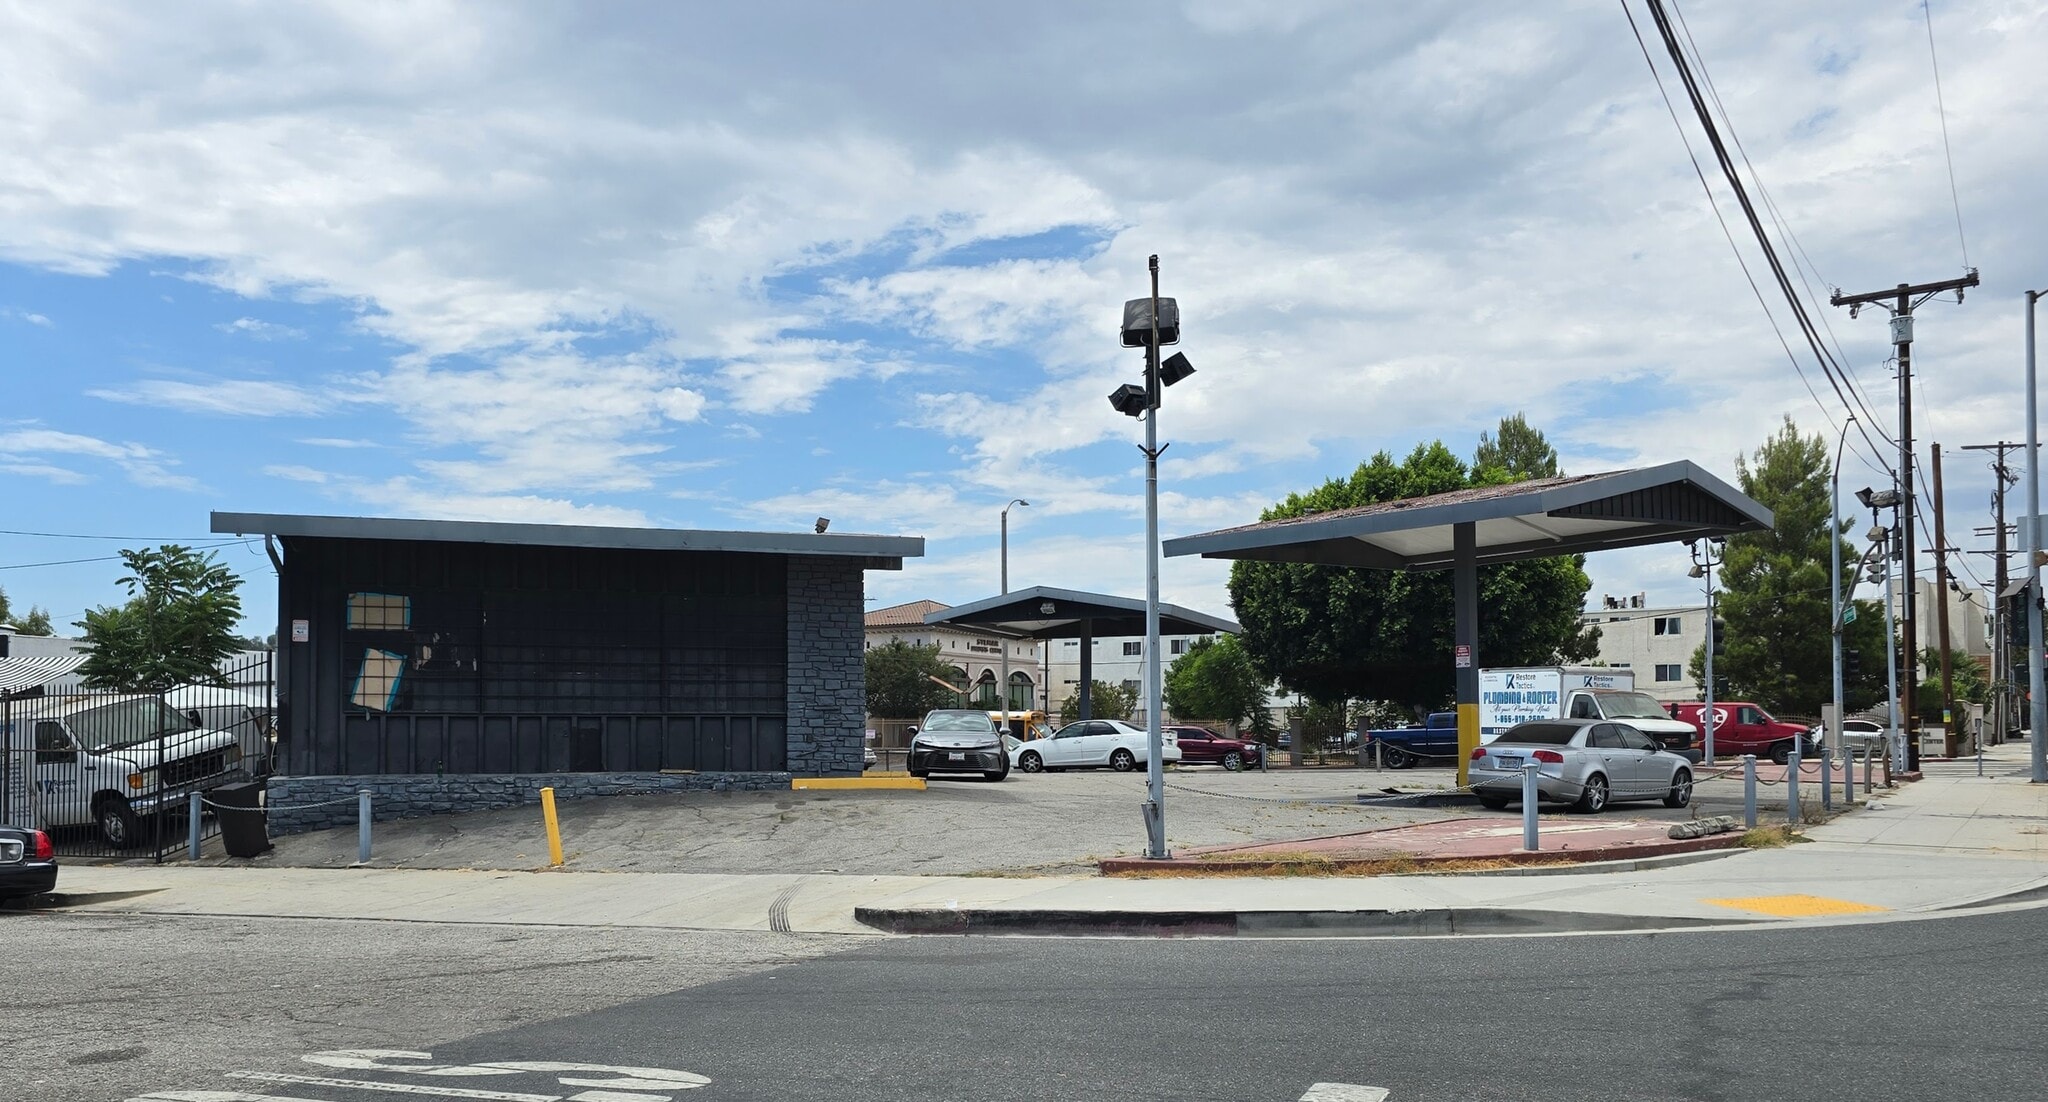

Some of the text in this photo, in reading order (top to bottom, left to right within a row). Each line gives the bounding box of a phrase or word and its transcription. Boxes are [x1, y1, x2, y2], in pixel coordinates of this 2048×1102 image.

[1515, 673, 1536, 681] Restore
[1483, 691, 1521, 704] PLUMBING
[1526, 691, 1558, 704] ROOTER
